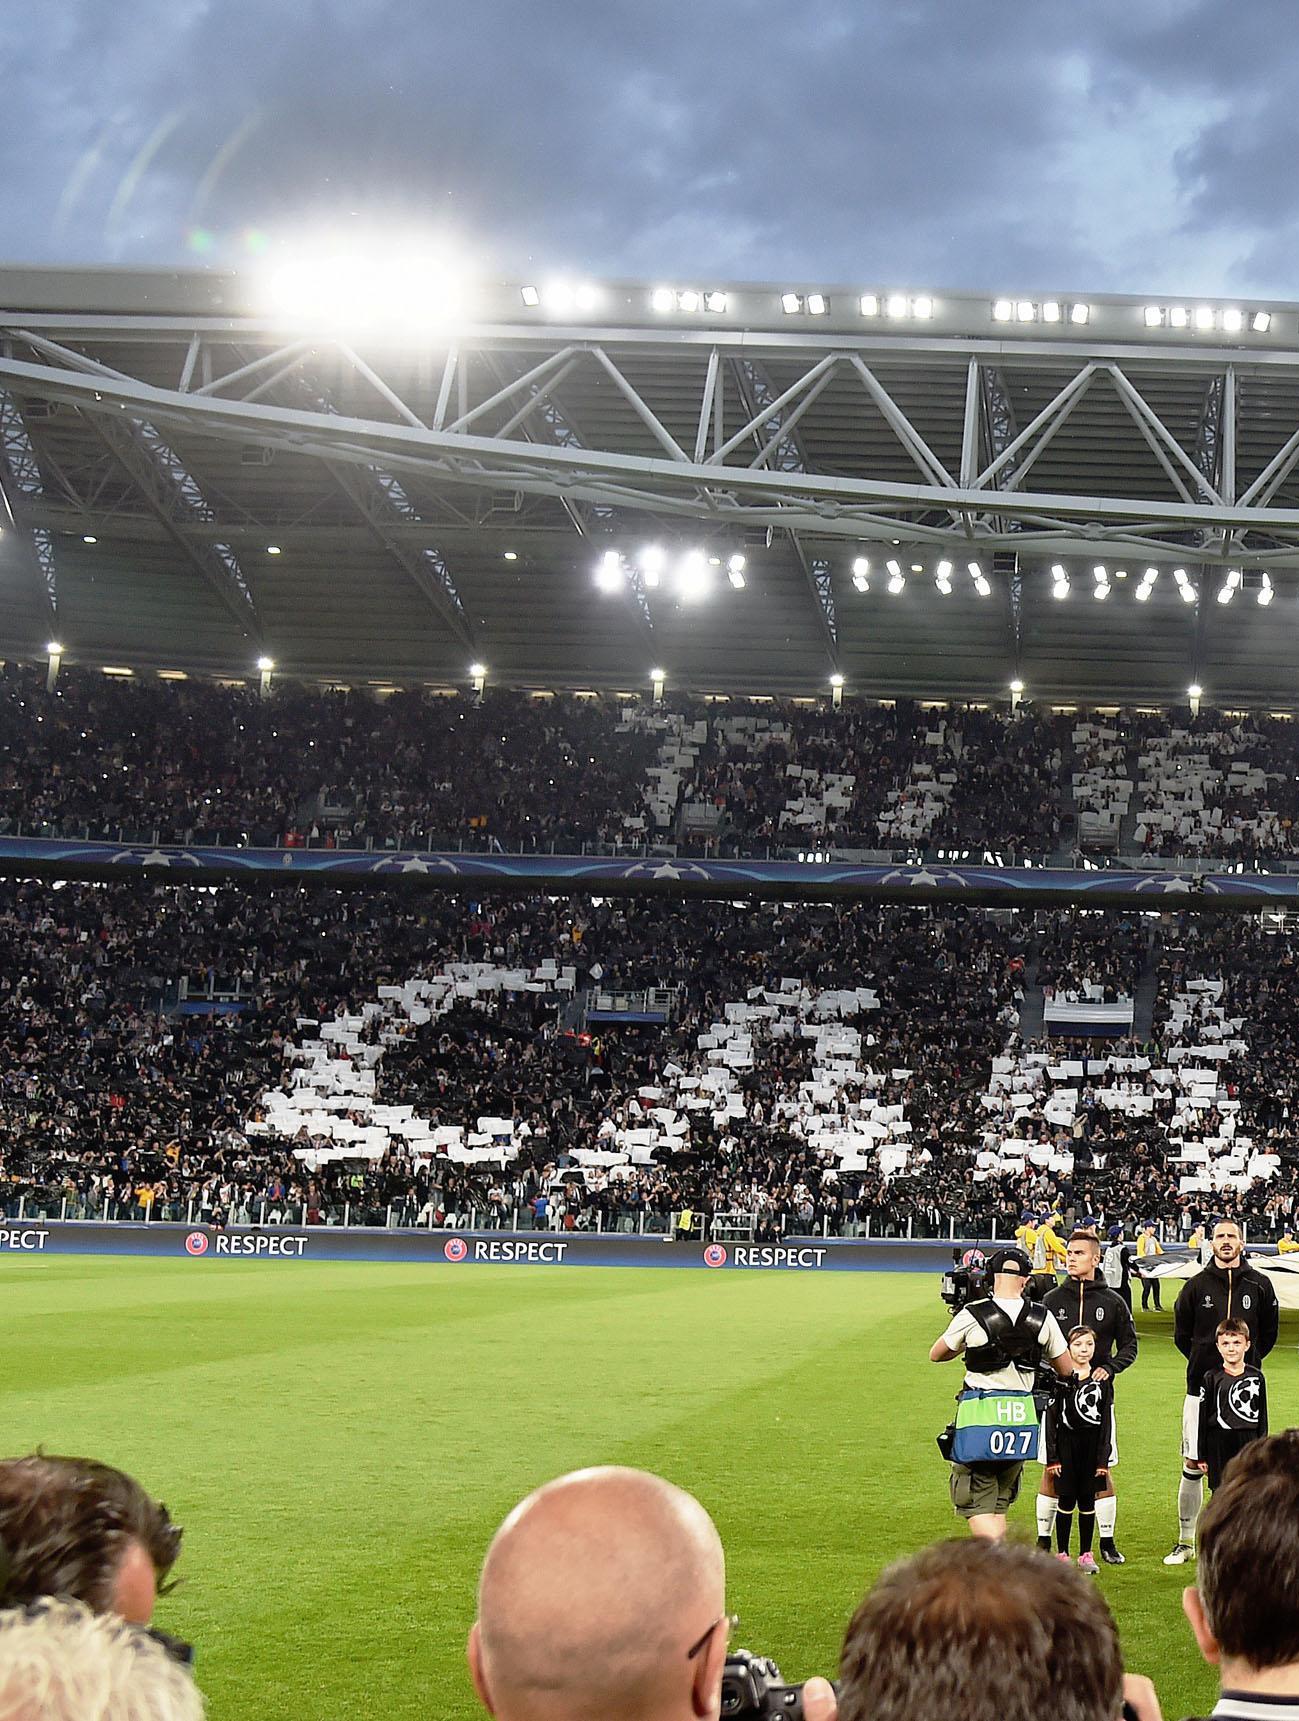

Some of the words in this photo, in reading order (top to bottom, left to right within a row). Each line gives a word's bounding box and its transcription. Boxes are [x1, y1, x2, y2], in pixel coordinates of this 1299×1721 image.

[217, 1235, 308, 1255] RESPECT
[475, 1241, 568, 1261] RESPECT
[735, 1247, 827, 1267] RESPECT
[997, 1401, 1027, 1423] HB
[990, 1430, 1032, 1455] 027
